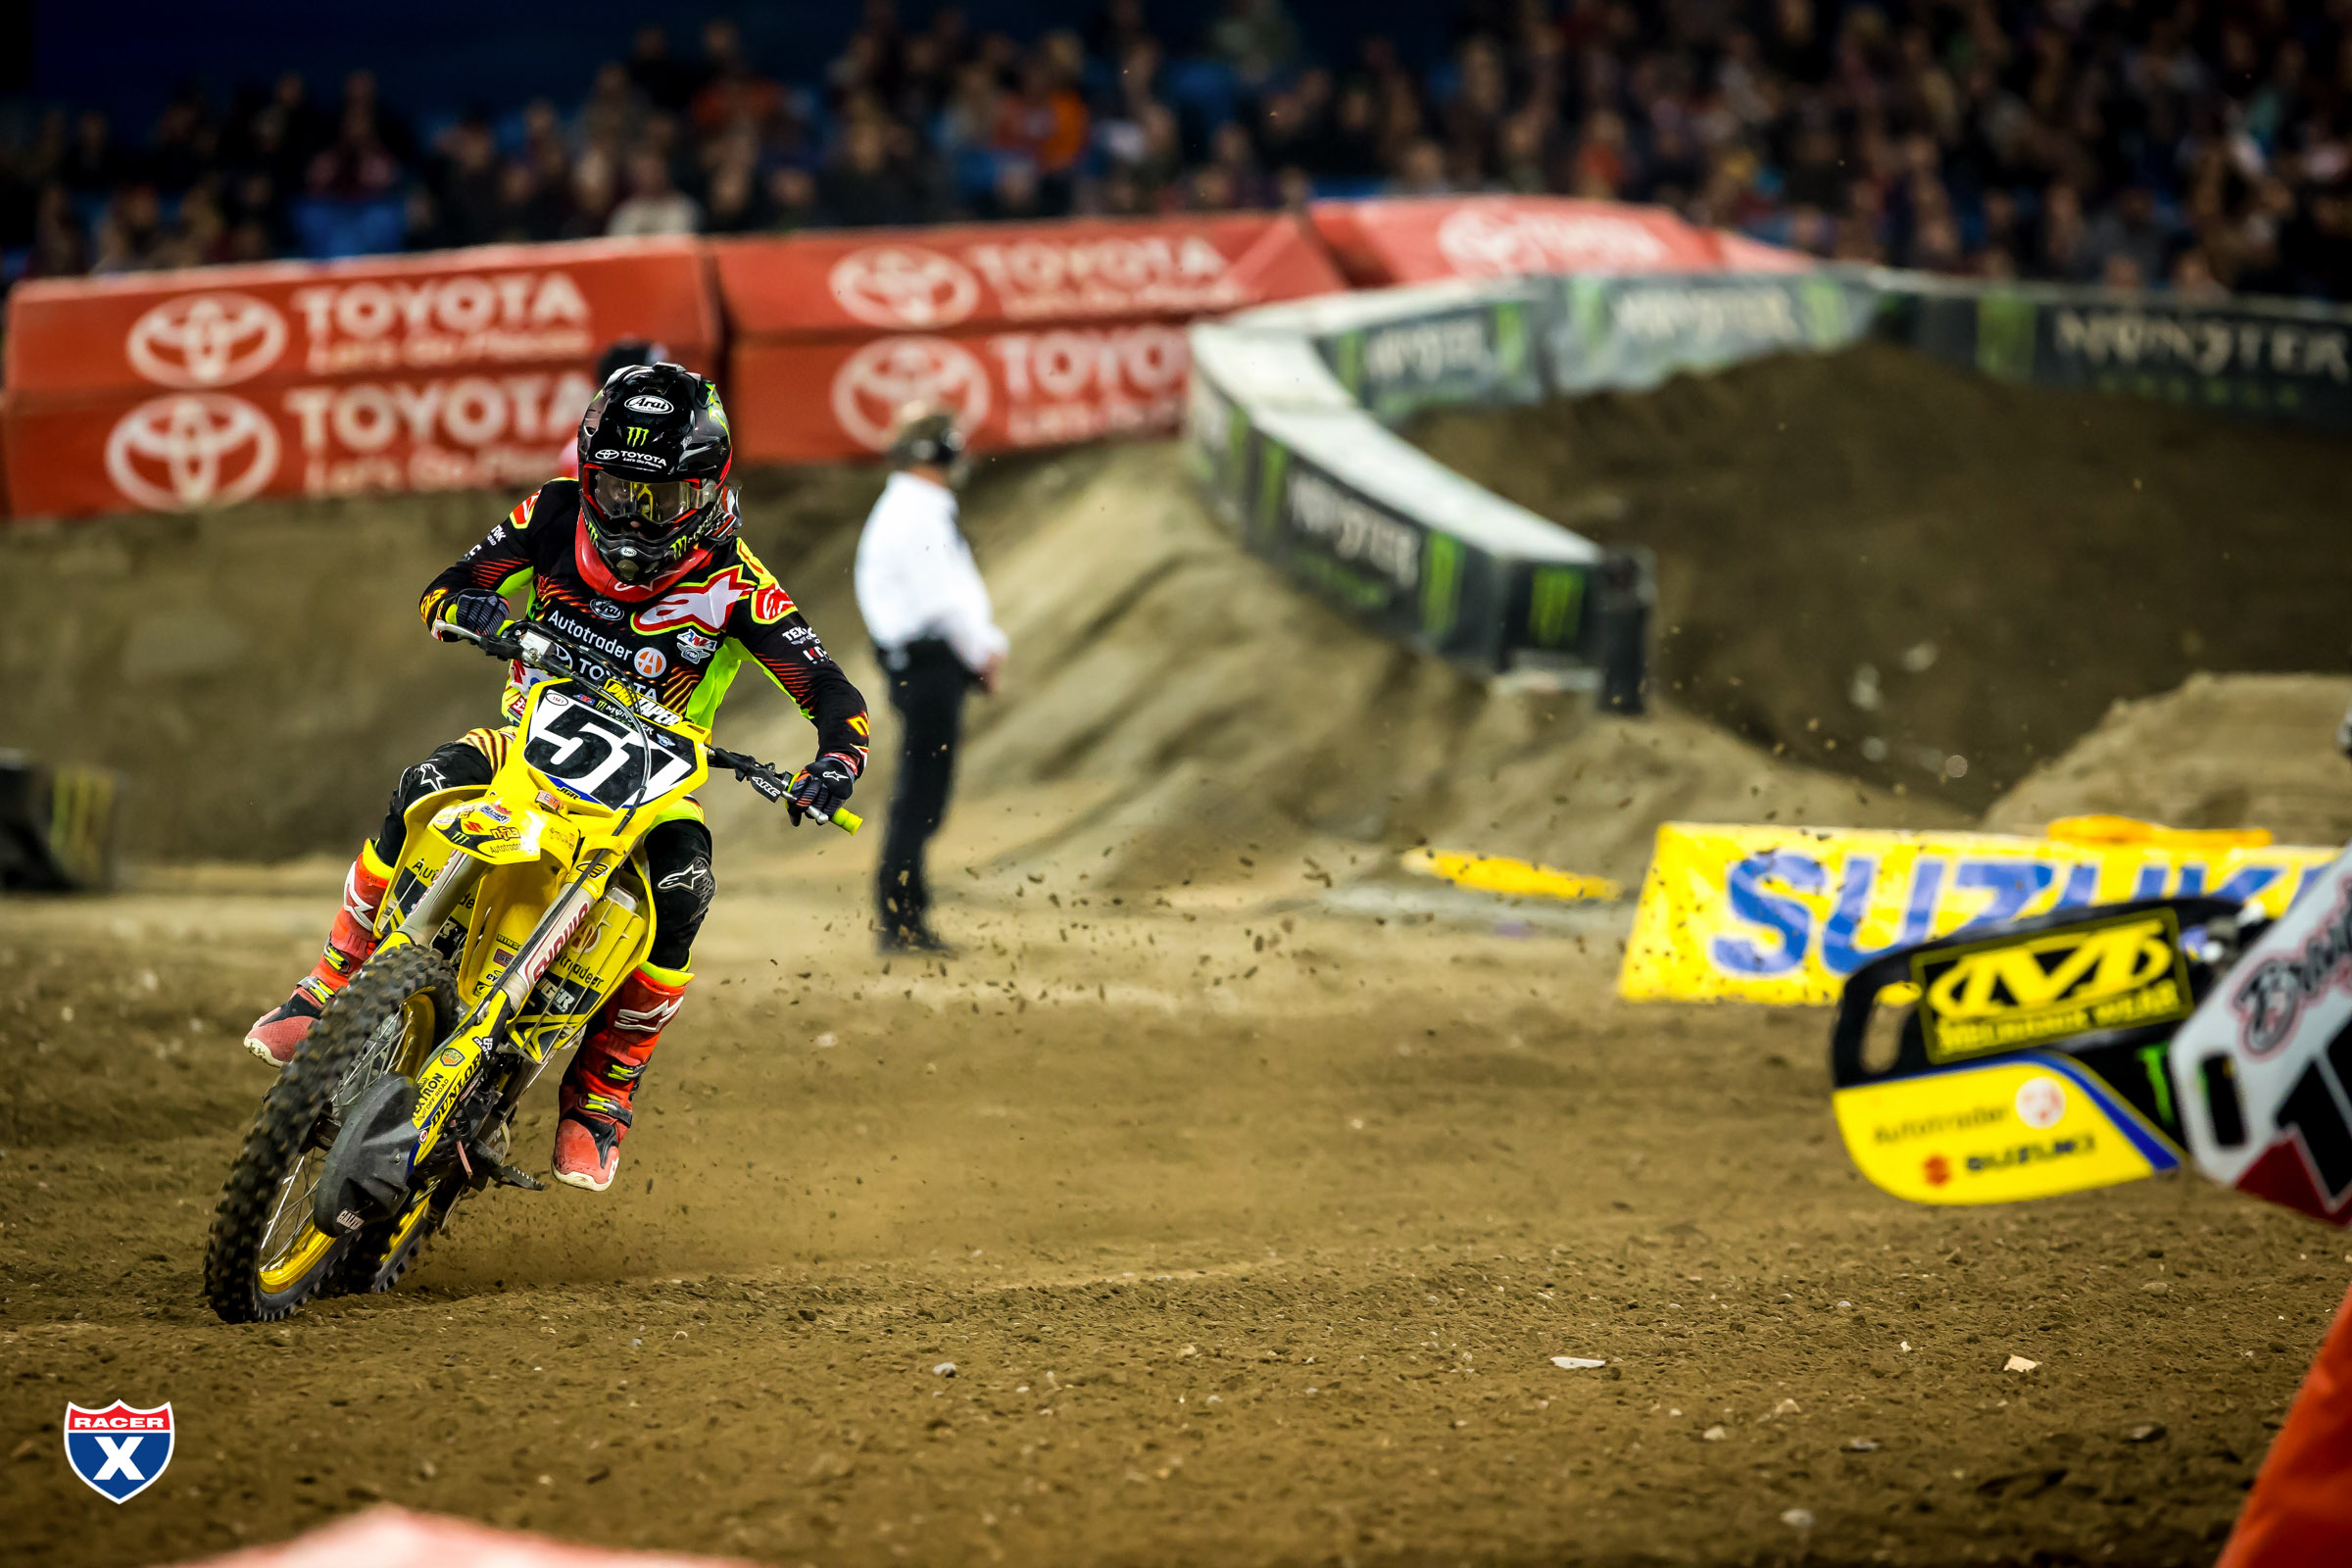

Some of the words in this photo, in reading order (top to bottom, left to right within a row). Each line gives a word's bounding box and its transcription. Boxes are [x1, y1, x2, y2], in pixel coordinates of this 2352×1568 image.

[968, 236, 1228, 294] TOYOTA
[292, 271, 588, 340] TOYOTA
[987, 324, 1190, 400] TOYO
[283, 369, 592, 453] TOYOTA
[620, 450, 667, 466] TOYOTA
[547, 609, 633, 662] Autotrader
[679, 630, 717, 651] AMA
[578, 658, 658, 703] TOTA
[636, 695, 683, 727] TAPER
[523, 704, 674, 812] 51
[557, 788, 580, 800] JGR
[752, 776, 781, 797] ARC
[413, 1072, 445, 1118] EXTRON
[425, 1096, 439, 1110] OFF
[434, 1077, 450, 1098] ROAD
[431, 1053, 482, 1127] DUNLOP
